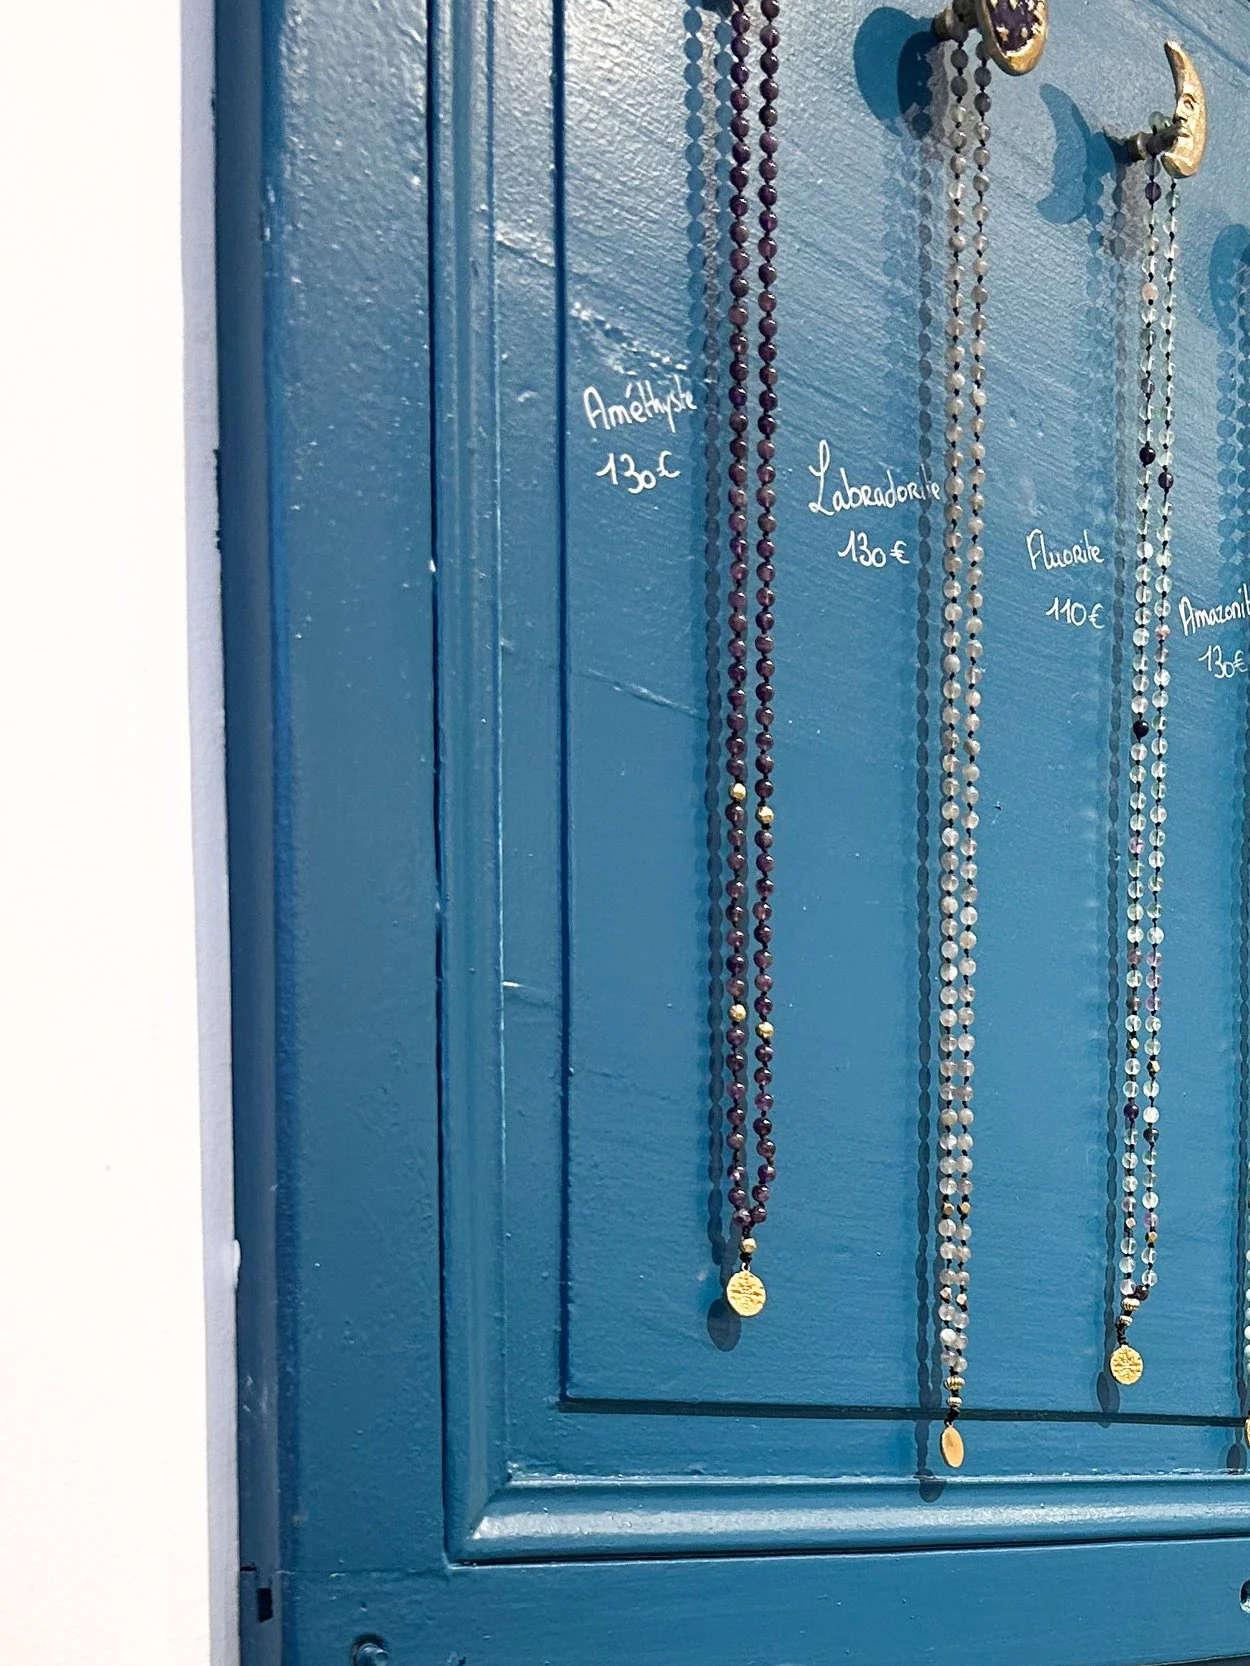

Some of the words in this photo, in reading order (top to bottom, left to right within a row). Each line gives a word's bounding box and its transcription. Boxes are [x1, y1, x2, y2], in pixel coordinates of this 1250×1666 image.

[583, 375, 697, 433] Améthyste
[597, 450, 680, 494] 130€
[808, 439, 942, 516] Labradorite
[838, 531, 910, 568] 130€
[1026, 528, 1105, 571] Fluorite
[1045, 597, 1105, 629] 110€
[1198, 645, 1248, 680] 130€
